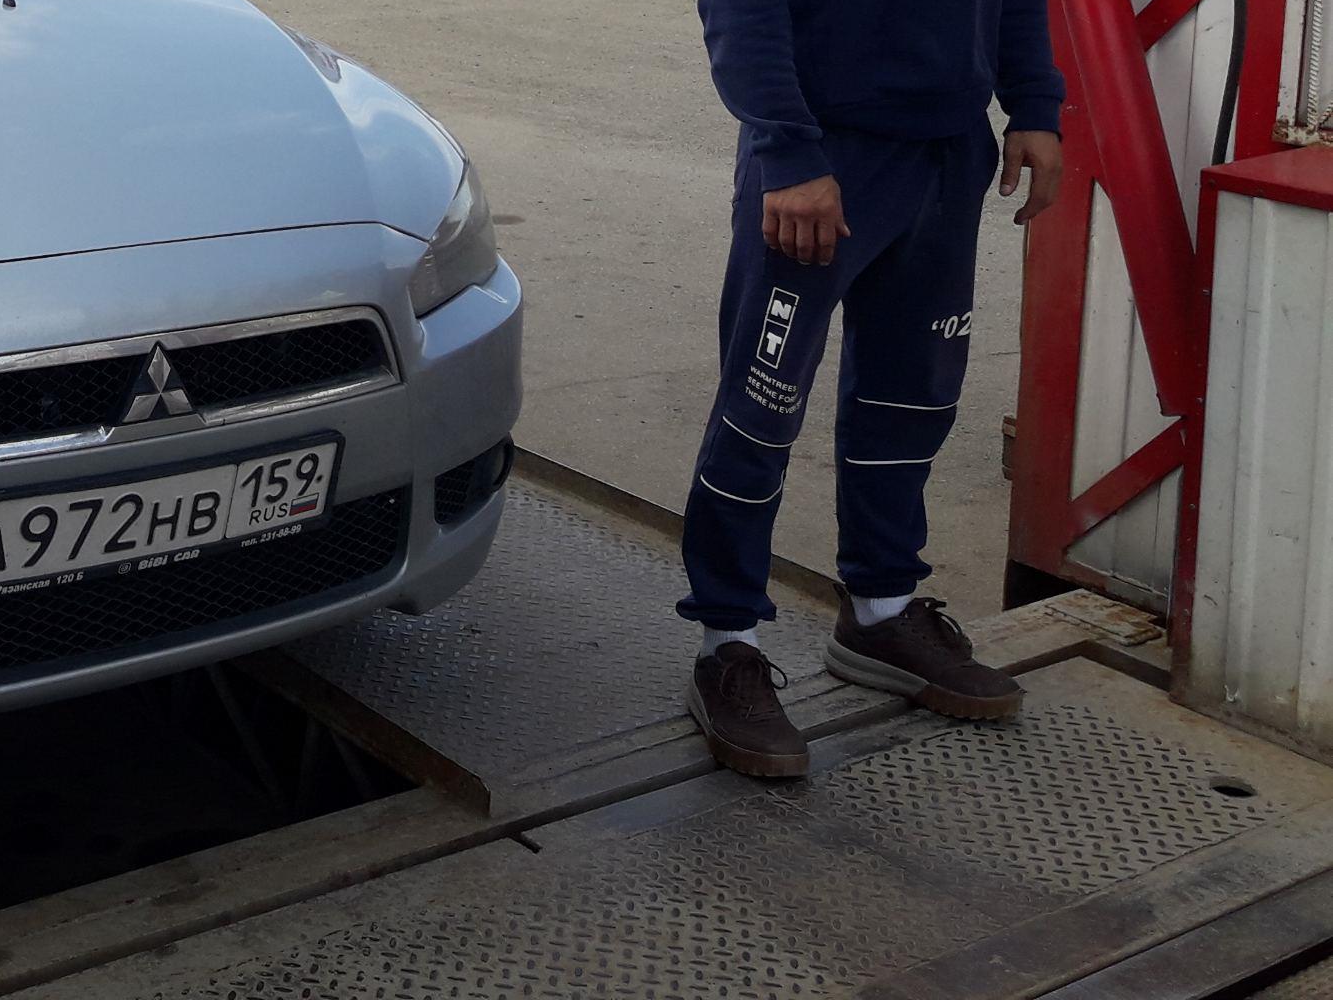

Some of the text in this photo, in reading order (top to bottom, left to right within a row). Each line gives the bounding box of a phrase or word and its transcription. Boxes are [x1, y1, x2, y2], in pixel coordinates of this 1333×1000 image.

[745, 386, 768, 407] THERE
[768, 401, 779, 411] IN
[747, 375, 762, 390] SEE
[762, 385, 778, 400] THE
[239, 452, 320, 508] 159
[249, 504, 288, 526] RUS
[56, 573, 74, 585] 120
